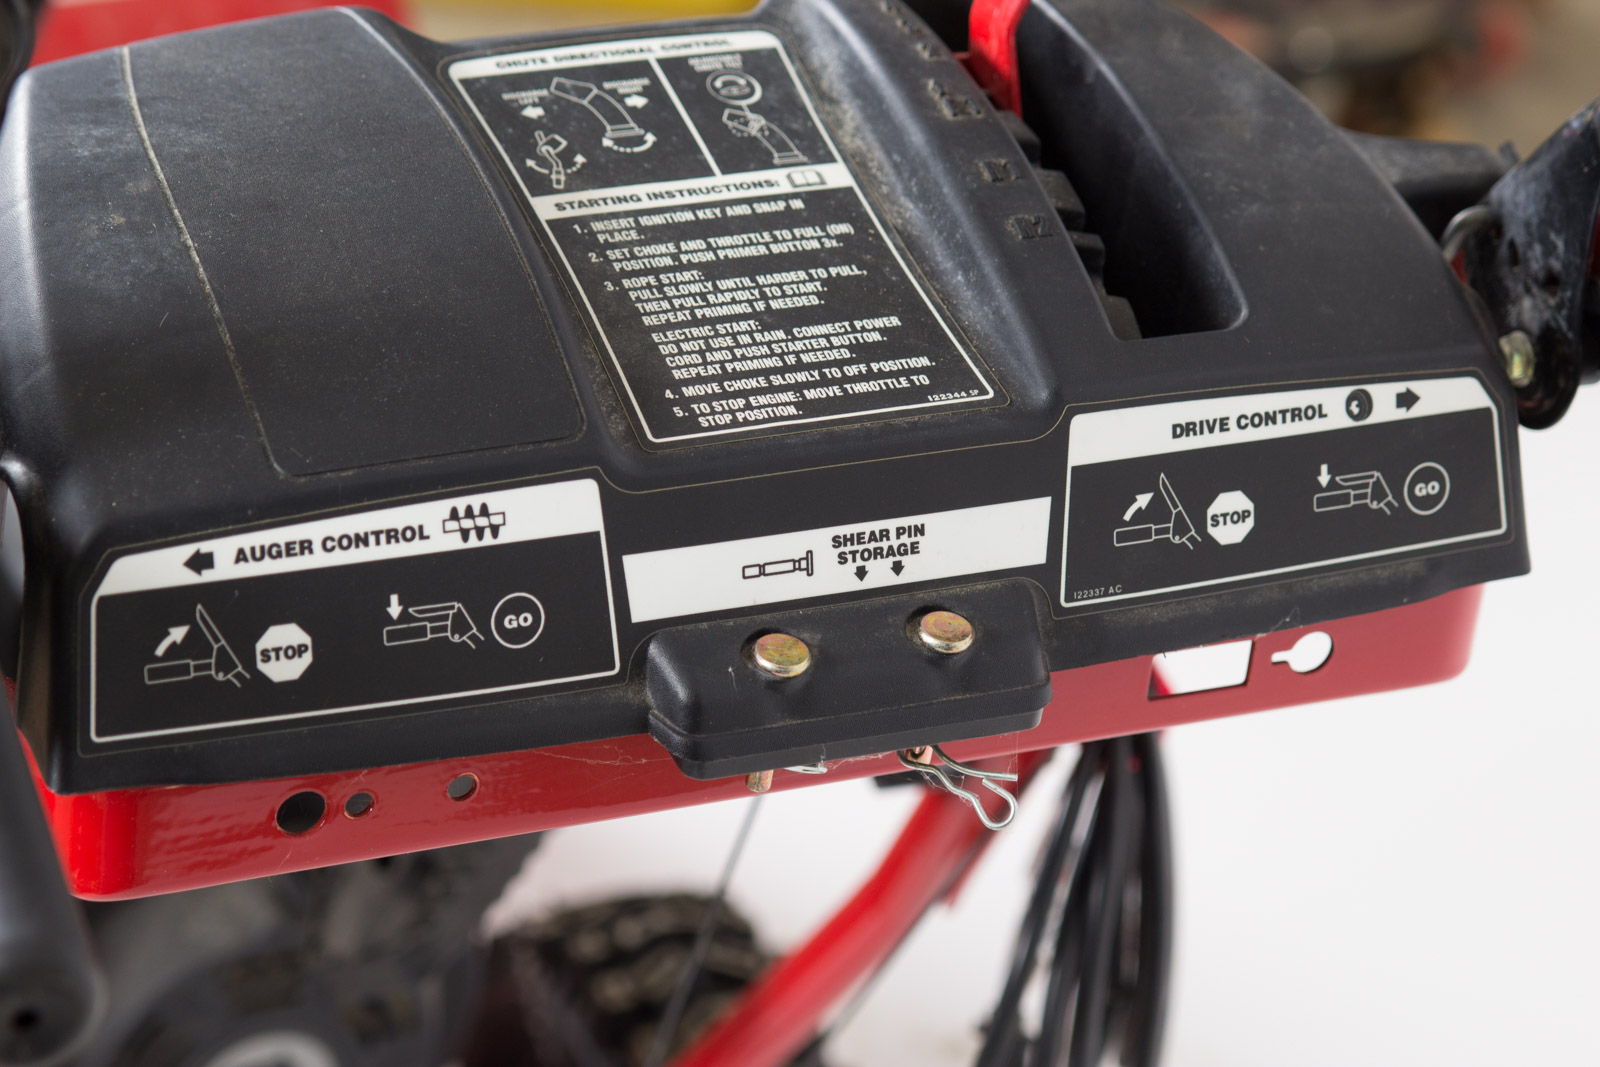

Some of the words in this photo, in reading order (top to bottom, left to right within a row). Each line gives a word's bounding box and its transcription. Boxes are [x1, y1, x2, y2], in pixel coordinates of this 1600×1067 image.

[496, 57, 548, 69] CHUTE
[554, 47, 653, 63] DIRECTIONAL
[661, 39, 730, 51] CONTROL
[555, 194, 643, 212] STARTING
[646, 179, 780, 201] INSTRUCTIONS:
[573, 223, 588, 234] 1.
[591, 217, 636, 232] INSERT
[638, 210, 696, 227] IGNITION
[696, 207, 722, 220] KEY
[726, 204, 753, 217] AND
[753, 200, 787, 214] SNAP
[789, 198, 805, 210] IN
[588, 252, 604, 263] 2.
[606, 247, 631, 261] SET
[634, 242, 679, 257] CHOKE
[680, 239, 707, 252] AND
[707, 231, 774, 248] THROTTLE
[773, 229, 793, 241] TO
[793, 225, 827, 239] FULL
[826, 222, 855, 237] (ON)
[597, 229, 645, 244] PLACE.
[613, 255, 679, 272] POSITION.
[680, 250, 717, 265] PUSH
[717, 244, 770, 260] PRIMER
[769, 238, 822, 254] BUTTON
[821, 237, 844, 249] 3x.
[604, 280, 620, 292] 3.
[622, 275, 659, 289] ROPE
[659, 269, 705, 285] START:
[629, 287, 664, 301] PULL
[664, 280, 714, 297] SLOWLY
[716, 276, 756, 291] UNTIL
[756, 270, 810, 286] HARDER
[809, 268, 829, 280] TO
[829, 264, 868, 278] PULL,
[635, 299, 672, 314] THEN
[672, 295, 707, 309] PULL
[707, 288, 761, 305] RAPIDLY
[763, 286, 782, 298] TO
[783, 281, 828, 296] START.
[642, 310, 692, 326] REPEAT
[694, 303, 753, 319] PRIMING
[753, 301, 767, 312] IF
[769, 295, 825, 310] NEEDED.
[652, 325, 715, 343] ELECTRIC
[716, 319, 762, 335] START:
[658, 343, 679, 355] DO
[680, 339, 707, 352] NOT
[709, 335, 737, 349] USE
[737, 333, 753, 345] IN
[753, 329, 792, 343] RAIN.
[793, 321, 852, 338] CONNECT
[853, 315, 902, 331] POWER
[666, 353, 703, 368] CORD
[706, 349, 733, 363] AND
[734, 344, 771, 359] PUSH
[771, 337, 831, 354] STARTER
[830, 330, 888, 347] BUTTON.
[672, 363, 723, 380] REPEAT
[725, 356, 784, 373] PRIMING
[784, 354, 798, 366] IF
[800, 348, 857, 364] NEEDED.
[665, 389, 679, 400] 4.
[682, 382, 723, 397] MOVE
[724, 376, 769, 392] CHOKE
[770, 369, 821, 386] SLOWLY
[822, 367, 842, 379] TO
[843, 363, 868, 377] OFF
[870, 356, 936, 373] POSITION.
[673, 406, 689, 418] 5.
[691, 402, 711, 415] TO
[712, 397, 746, 412] STOP
[749, 391, 803, 407] ENGINE:
[803, 385, 844, 400] MOVE
[844, 376, 911, 395] THROTTLE
[910, 374, 930, 386] TO
[698, 413, 733, 428] STOP
[736, 404, 803, 423] POSITION.
[1171, 417, 1231, 439] DRIVE
[1236, 403, 1328, 431] CONTROL
[1414, 481, 1440, 497] GO
[1210, 510, 1252, 528] STOP
[233, 539, 314, 565] AUGER
[321, 524, 431, 553] CONTROL
[831, 528, 890, 549] SHEAR
[895, 523, 926, 540] PIN
[837, 541, 920, 565] STORAGE
[1109, 585, 1122, 594] AC
[503, 612, 533, 629] GO
[259, 643, 310, 664] STOP
